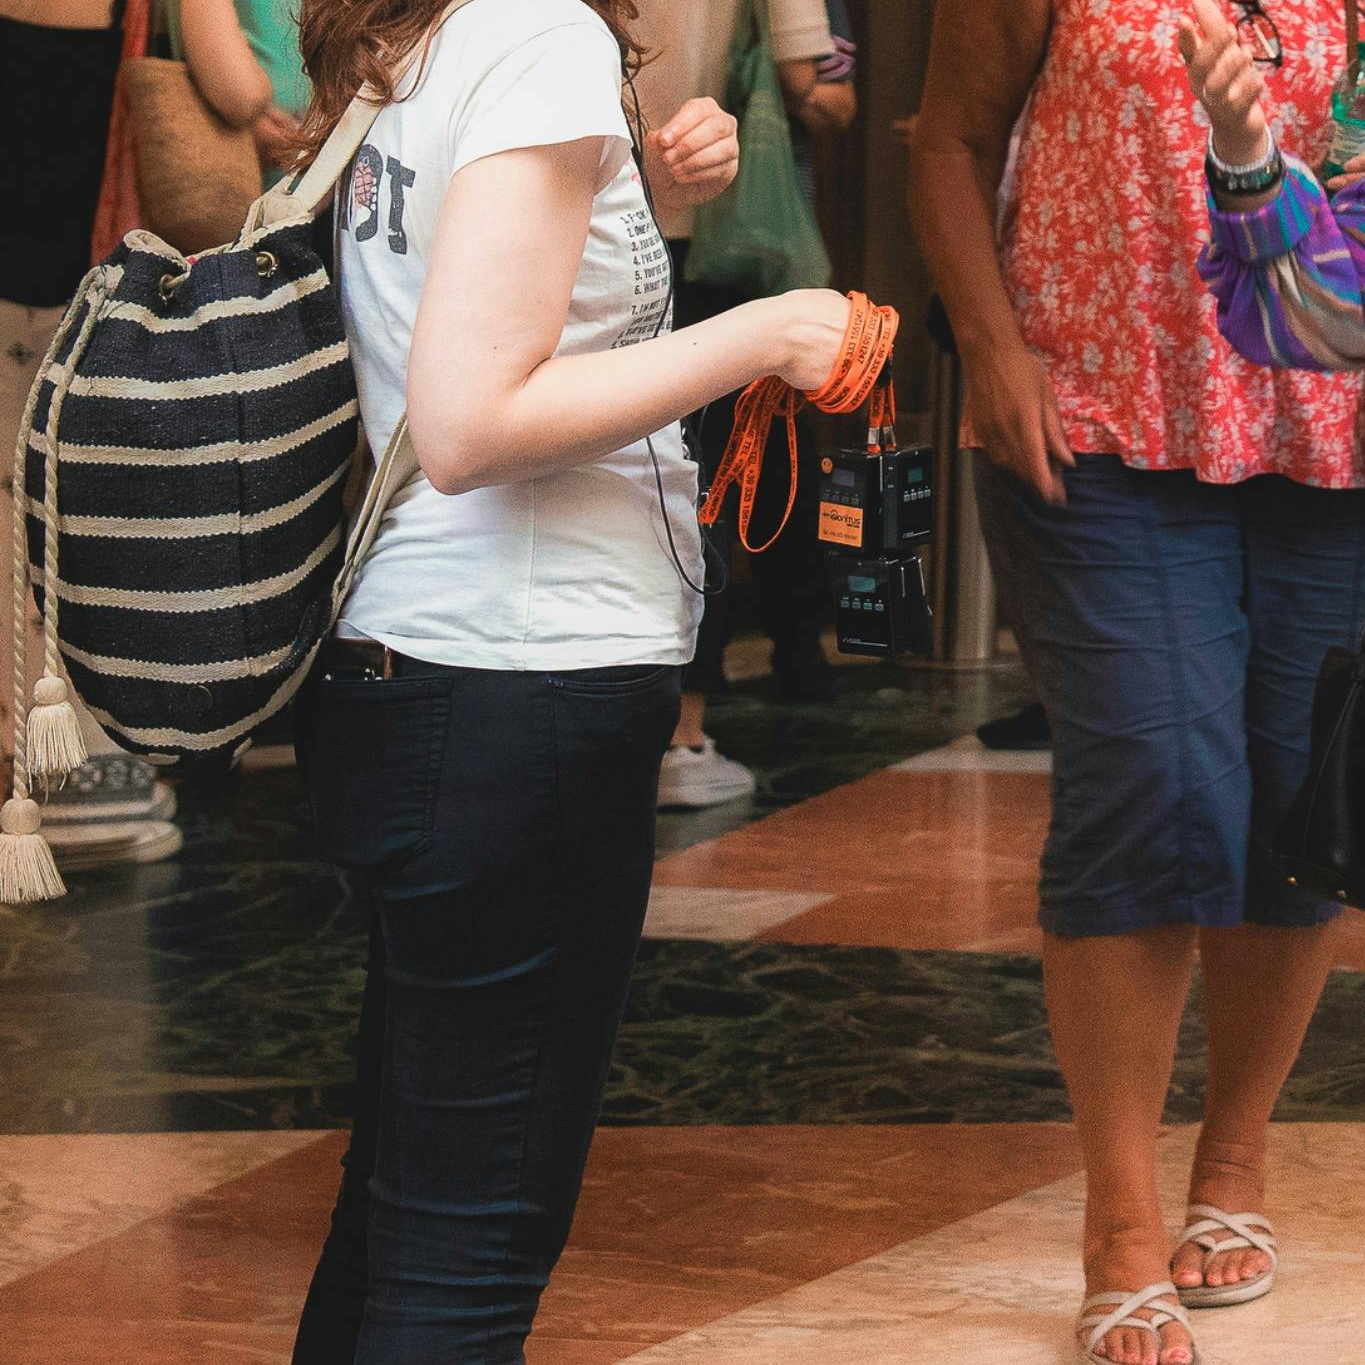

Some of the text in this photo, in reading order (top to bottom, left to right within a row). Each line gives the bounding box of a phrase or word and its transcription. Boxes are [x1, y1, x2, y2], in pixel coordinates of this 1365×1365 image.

[633, 255, 641, 266] 4.
[635, 270, 642, 280] 5.
[631, 305, 638, 315] 7.
